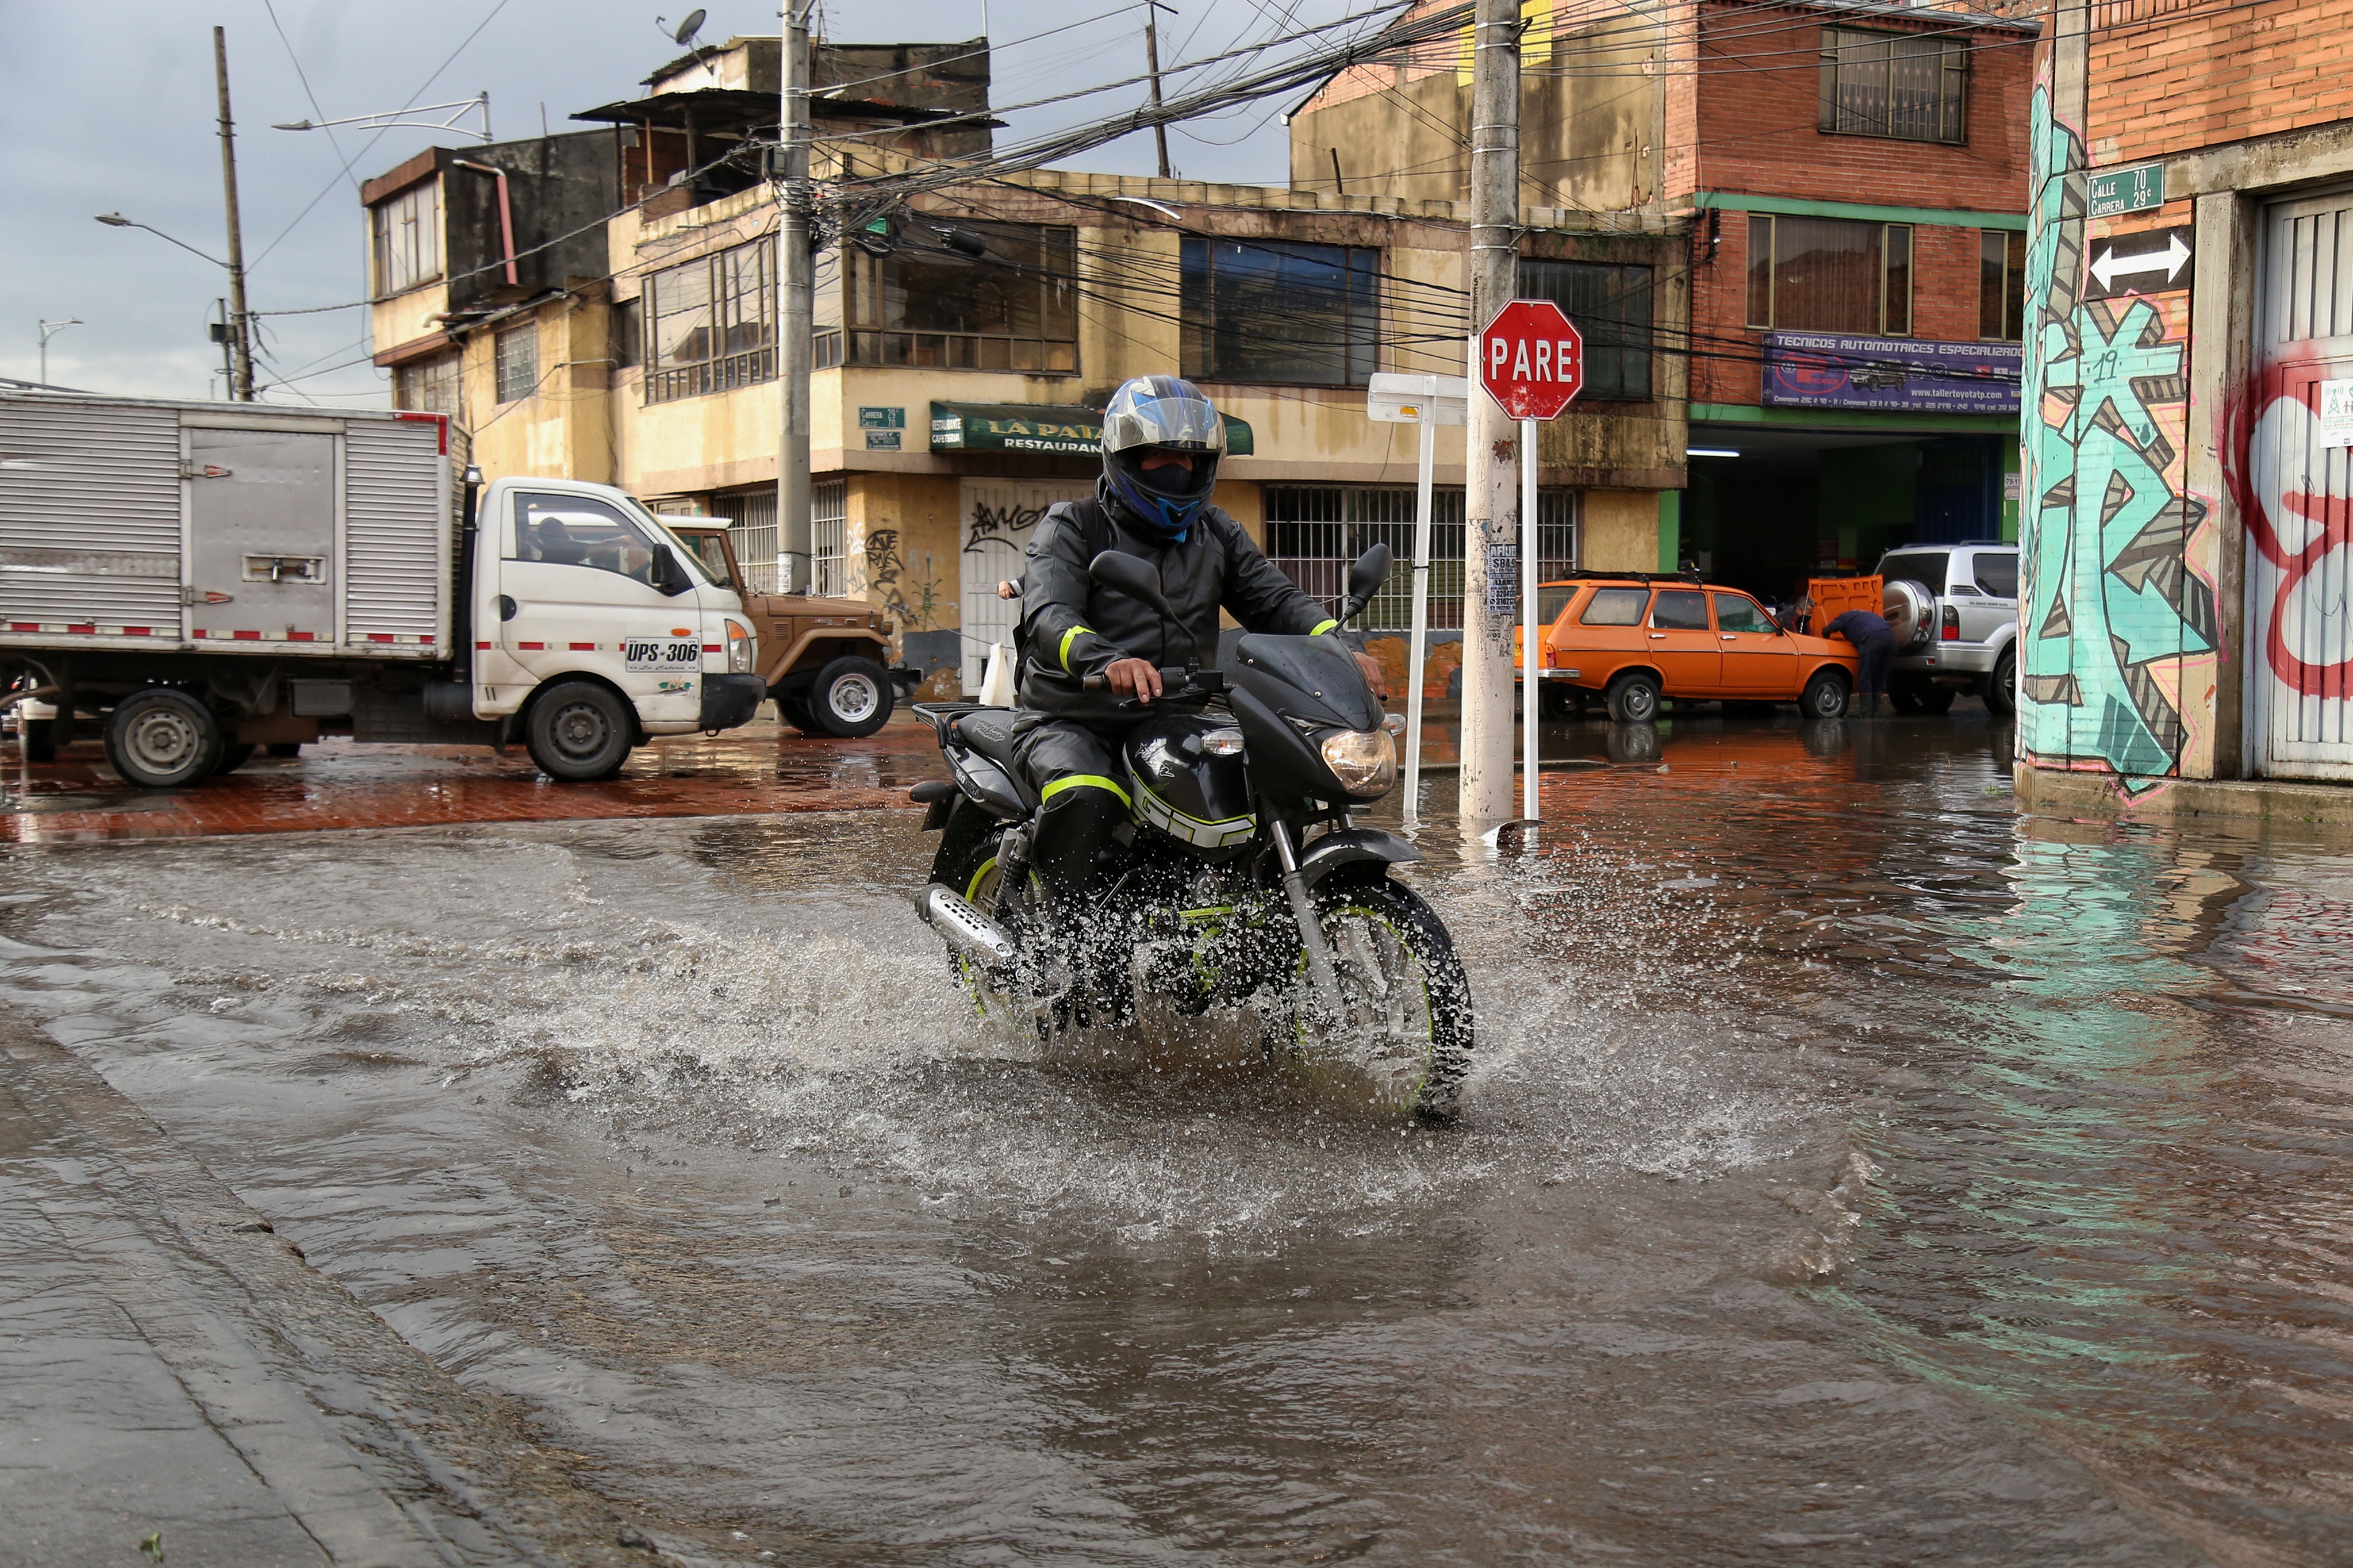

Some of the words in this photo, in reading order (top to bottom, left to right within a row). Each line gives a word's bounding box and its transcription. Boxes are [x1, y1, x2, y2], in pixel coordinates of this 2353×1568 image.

[2134, 169, 2146, 191] 70
[1778, 335, 1836, 349] TECNICOS
[1840, 340, 1935, 354] AUTOMOTRICES
[1491, 338, 1572, 383] PARE
[1911, 388, 2002, 400] www.tallertoyotatp.com
[888, 419, 895, 427] 70
[932, 418, 962, 431] RESTAURANTE
[988, 421, 1031, 435] LA
[932, 433, 960, 443] CAFETERIA
